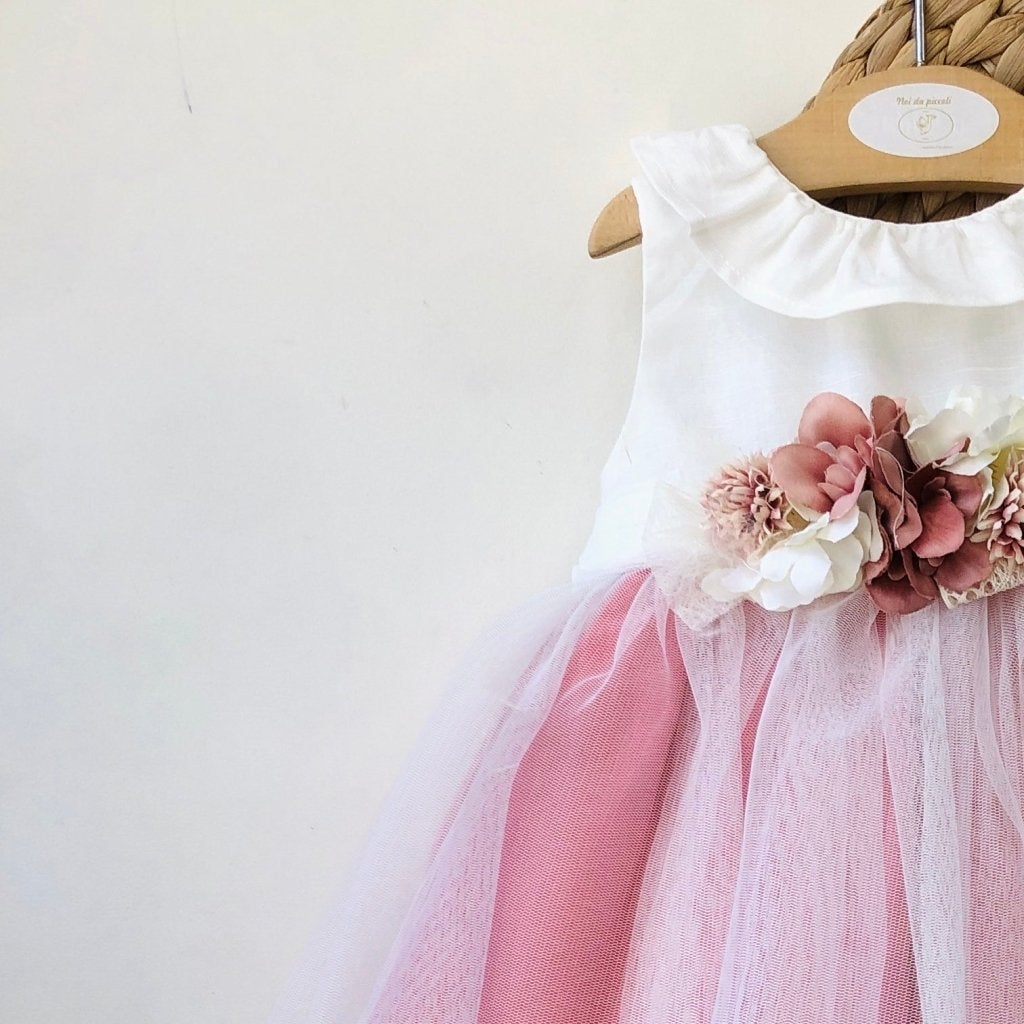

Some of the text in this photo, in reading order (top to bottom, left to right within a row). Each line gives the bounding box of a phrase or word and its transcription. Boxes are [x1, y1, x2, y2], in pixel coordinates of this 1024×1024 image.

[896, 97, 952, 107] Noi da piccoli
